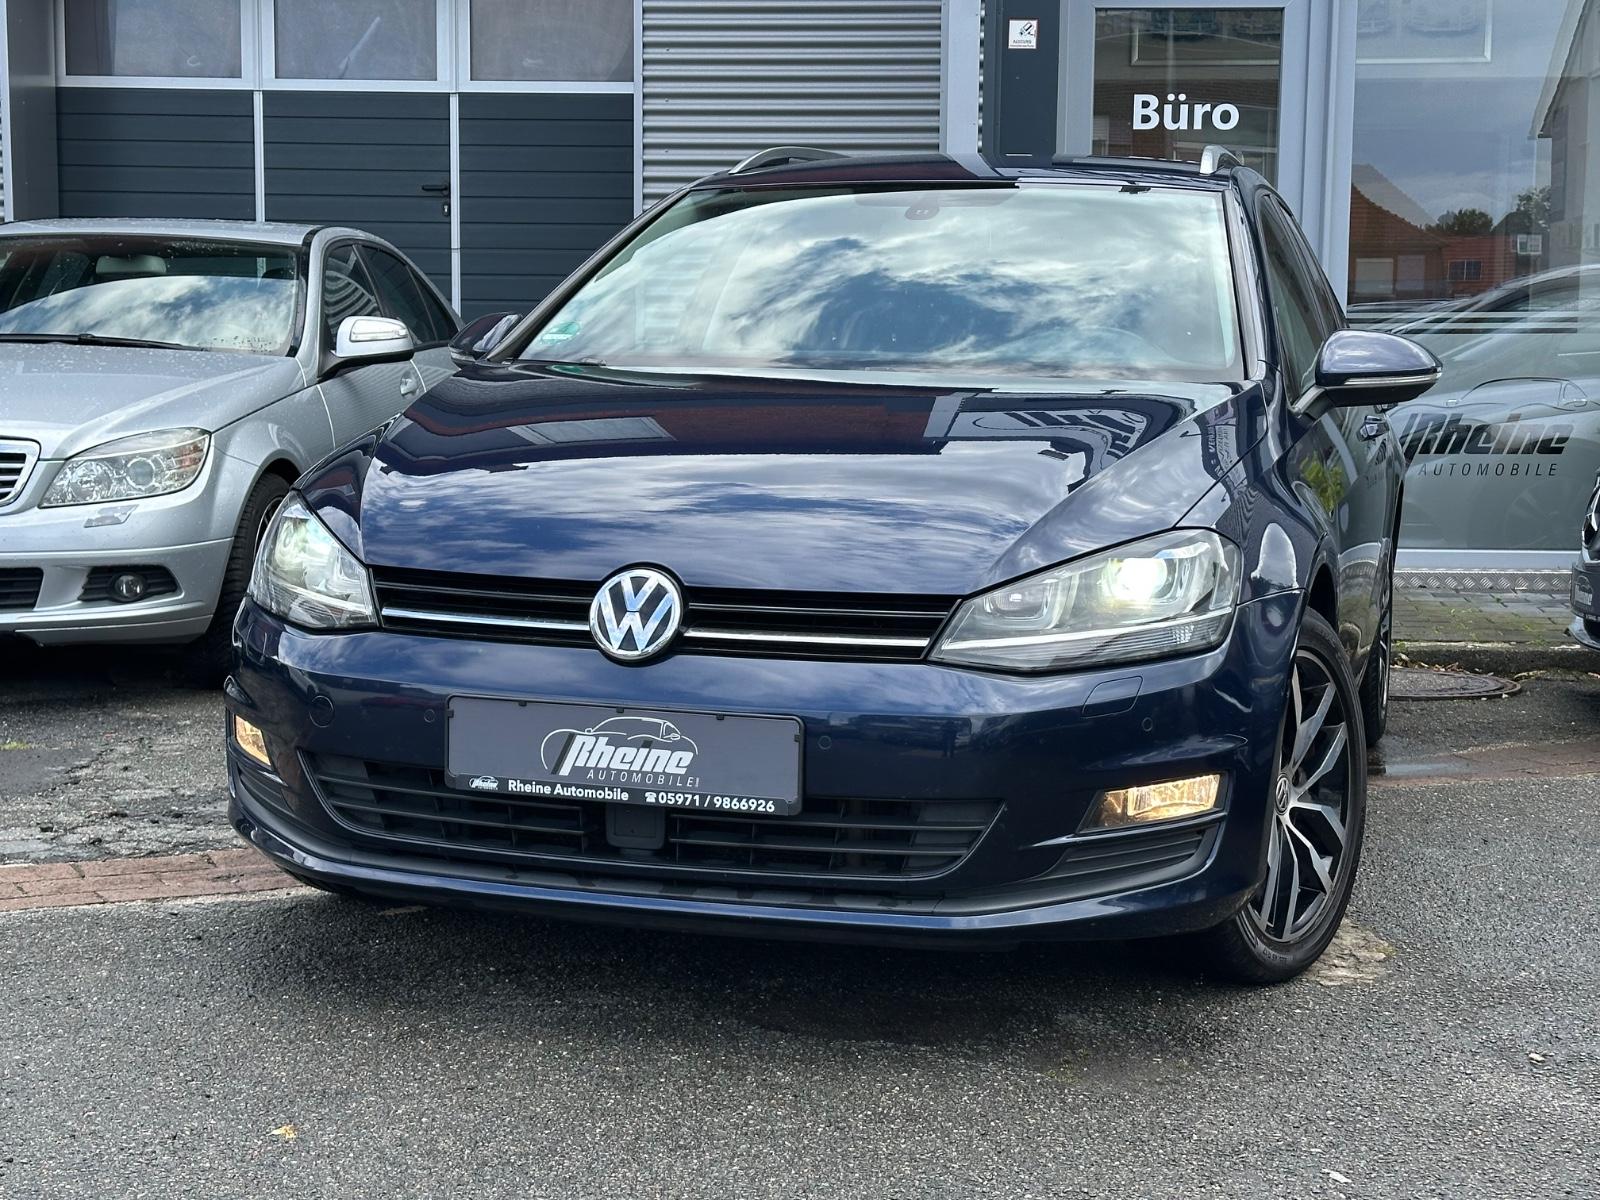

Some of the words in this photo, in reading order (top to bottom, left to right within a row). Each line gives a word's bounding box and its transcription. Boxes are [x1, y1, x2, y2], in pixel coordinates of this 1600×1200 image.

[1133, 93, 1240, 130] Büro
[1402, 413, 1575, 468] Rheine
[1418, 463, 1558, 476] AUTOMOBILE
[597, 574, 674, 652] VW
[558, 735, 694, 776] Rheine
[508, 779, 551, 794] Rheine
[554, 783, 629, 800] Automobile
[658, 792, 700, 806] 05971
[703, 795, 711, 807] /
[713, 796, 775, 812] 9866926
[586, 769, 696, 787] AUTOMOBILE
